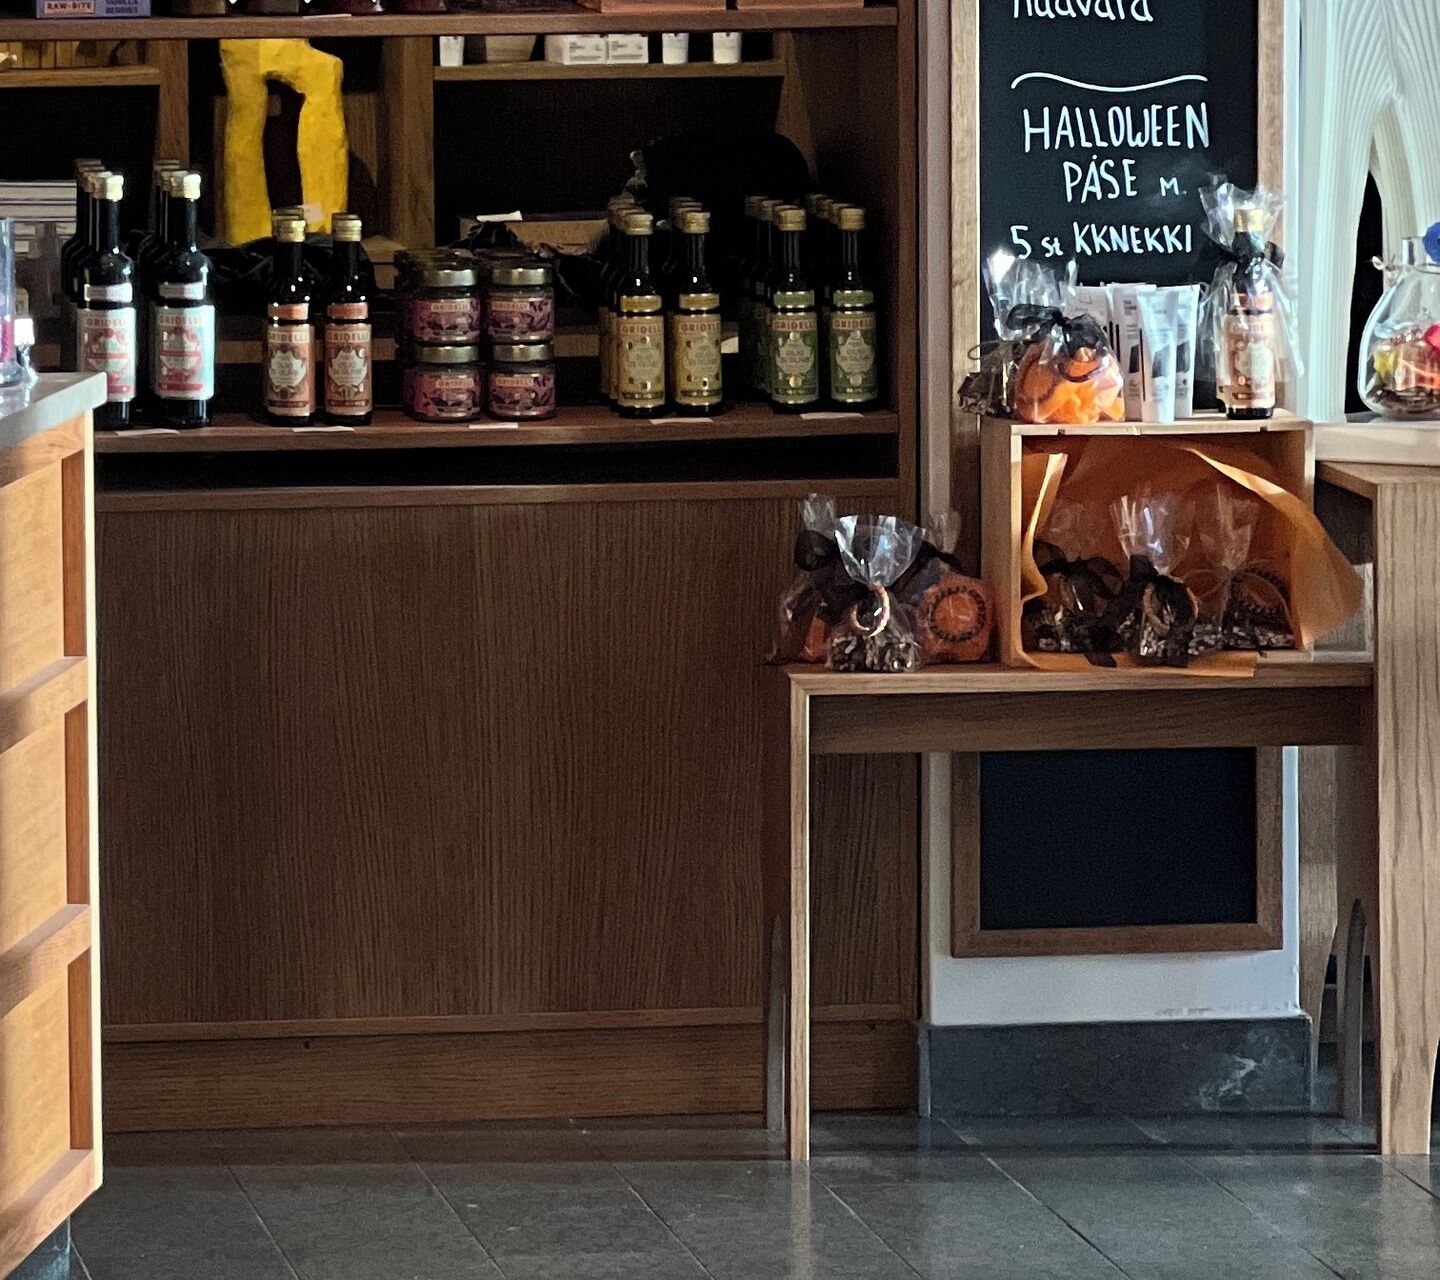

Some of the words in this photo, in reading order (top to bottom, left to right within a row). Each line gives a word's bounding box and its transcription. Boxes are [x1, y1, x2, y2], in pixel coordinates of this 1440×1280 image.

[1022, 102, 1210, 153] HALLOWEEN
[1062, 155, 1139, 204] PÅSE
[1010, 224, 1031, 260] 5
[1072, 220, 1193, 256] KKNEKKI
